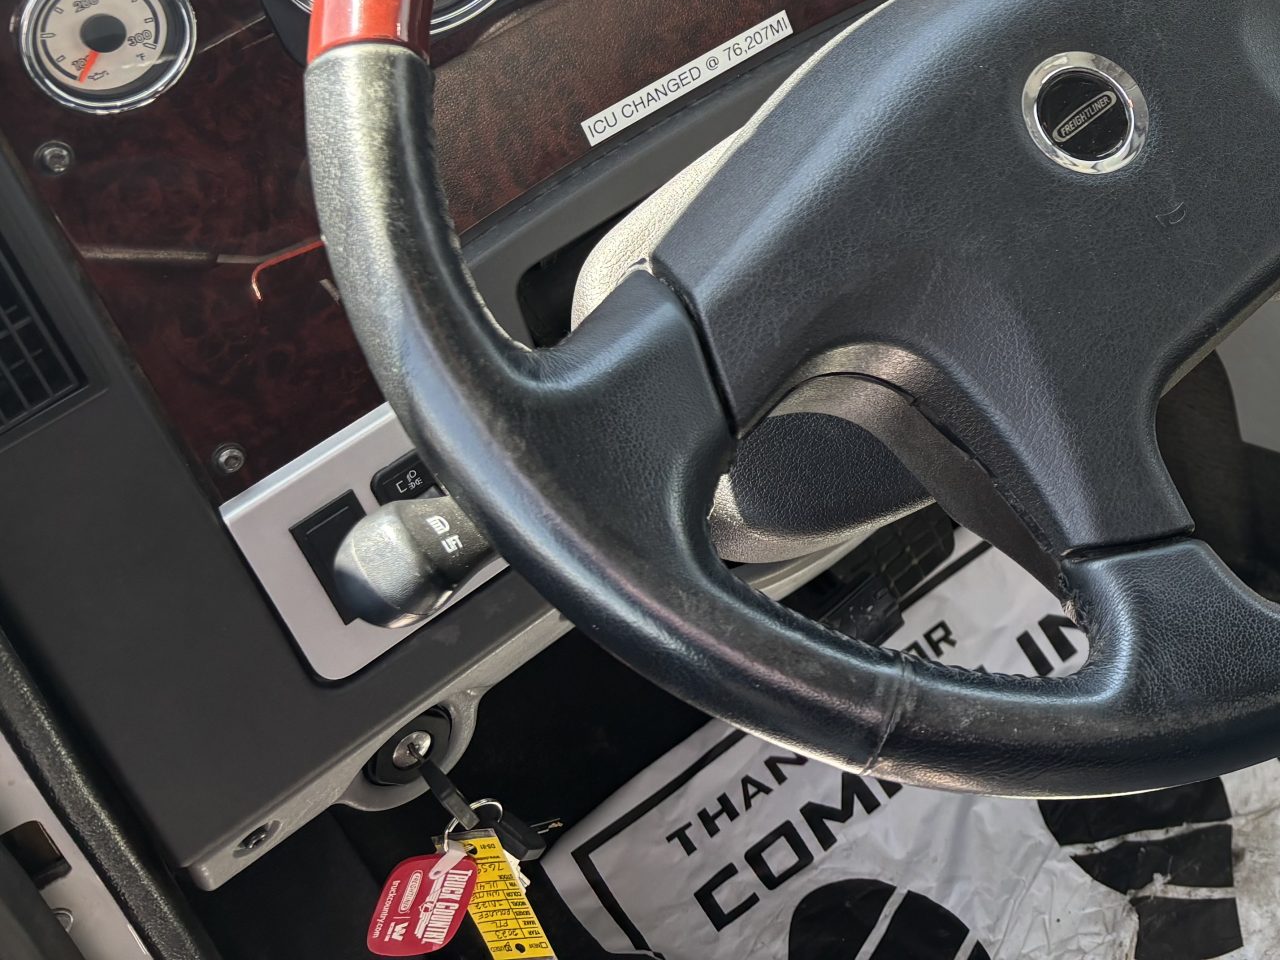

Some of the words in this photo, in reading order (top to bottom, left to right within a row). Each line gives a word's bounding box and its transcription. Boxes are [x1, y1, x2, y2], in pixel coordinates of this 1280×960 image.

[127, 30, 152, 46] 300
[587, 112, 617, 138] ICU
[621, 65, 701, 119] CHANGED
[705, 55, 720, 71] @
[722, 17, 788, 62] 76,207MI
[1061, 96, 1110, 137] FREIGHTLINER
[665, 752, 809, 856] THAN
[402, 874, 420, 909] FREIGHTLINER
[439, 869, 473, 900] TRUCK
[373, 880, 401, 939] truckcountry.com
[421, 901, 459, 945] COUNTRY
